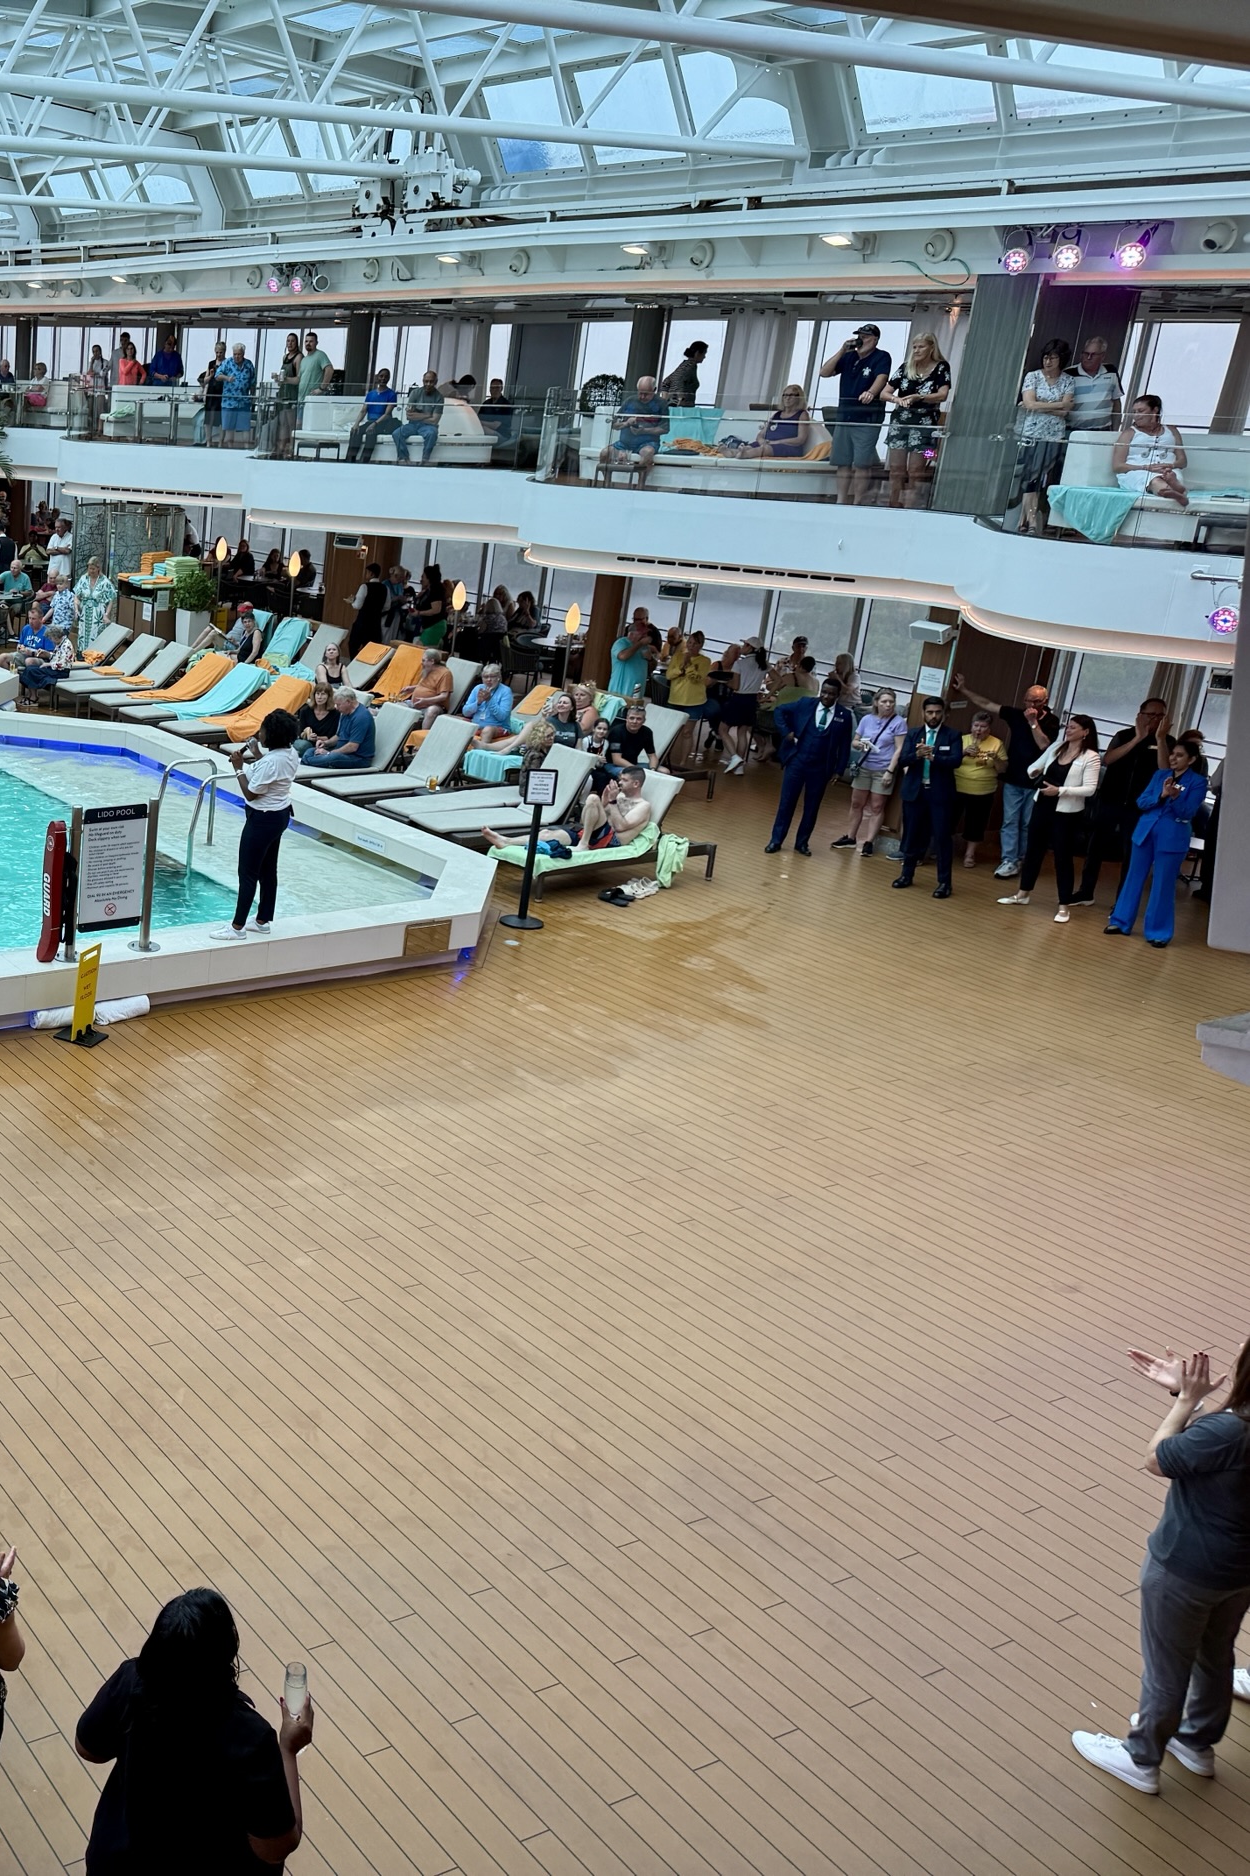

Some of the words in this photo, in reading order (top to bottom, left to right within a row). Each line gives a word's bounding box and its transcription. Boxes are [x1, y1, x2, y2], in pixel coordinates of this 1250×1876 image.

[97, 810, 115, 819] LIDO
[116, 808, 136, 816] POOL
[43, 872, 51, 917] GUARD
[80, 967, 97, 979] CAUTION
[83, 982, 92, 990] WET
[79, 991, 92, 1001] FLOOR
